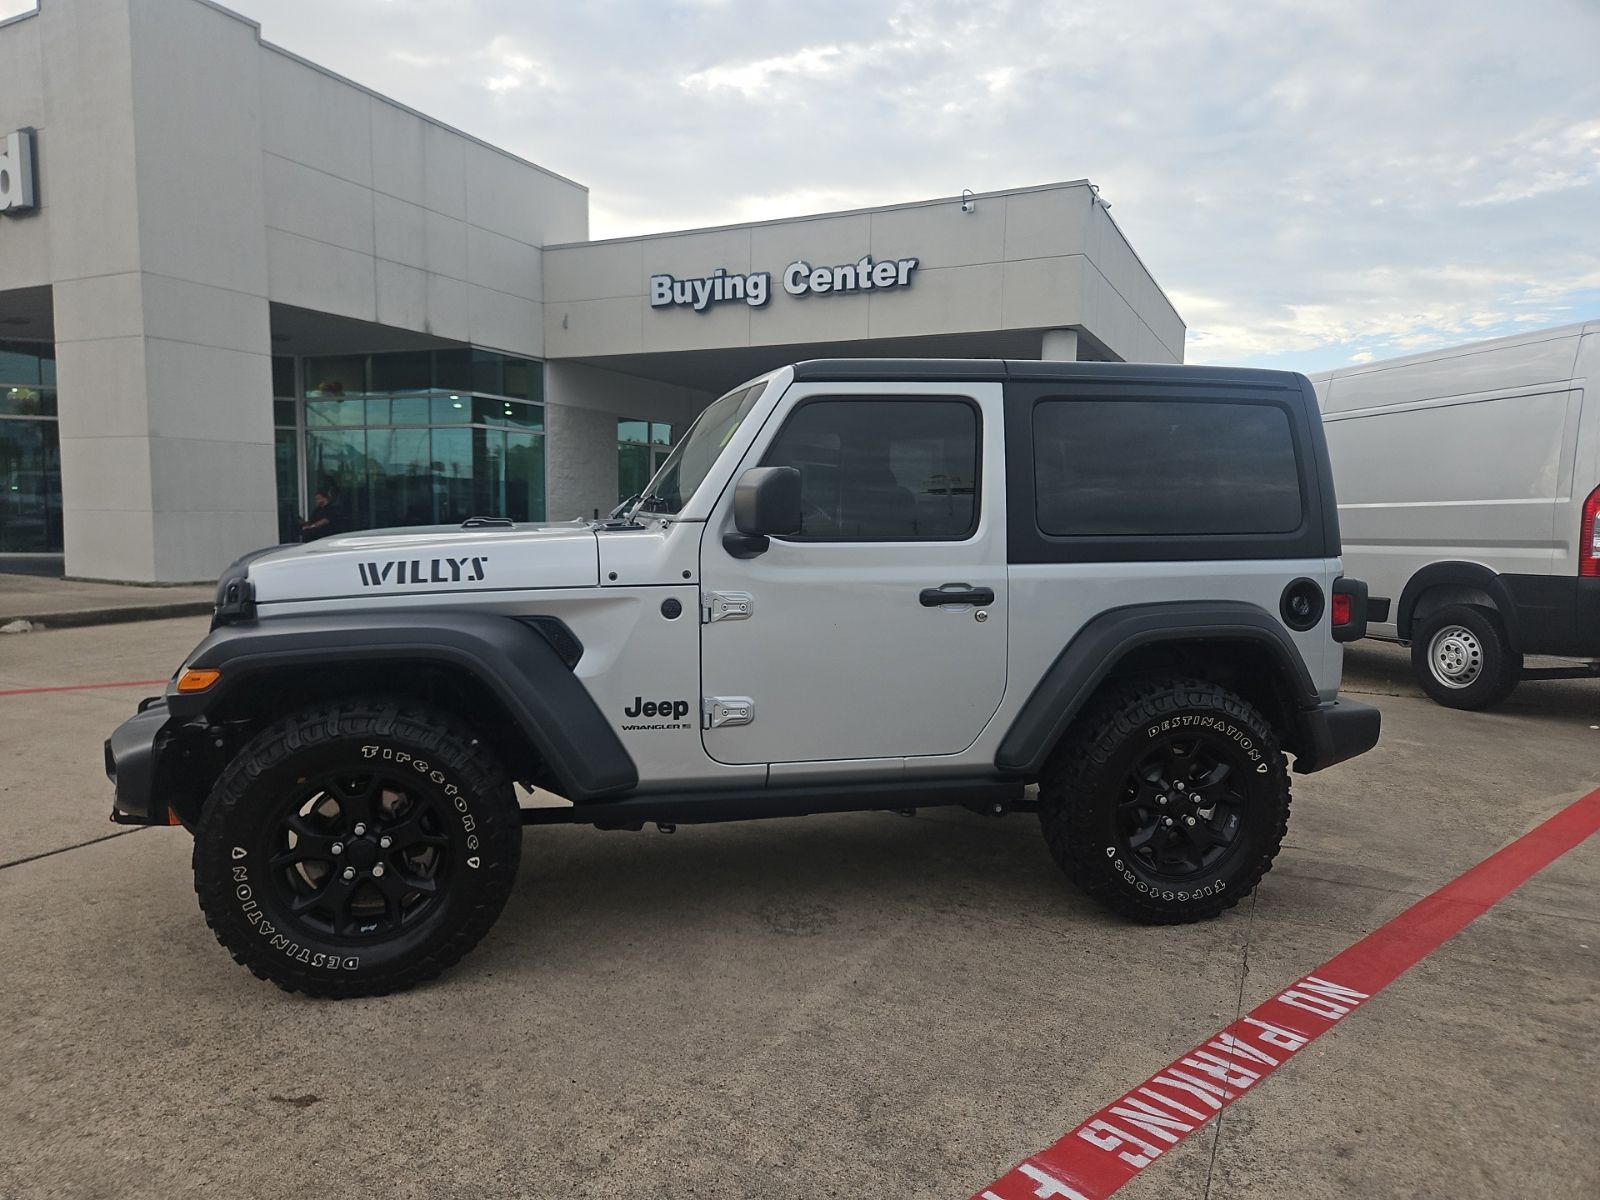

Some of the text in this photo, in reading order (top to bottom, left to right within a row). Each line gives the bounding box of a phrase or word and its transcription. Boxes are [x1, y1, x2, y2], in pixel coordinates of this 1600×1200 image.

[650, 255, 919, 313] Buying Center
[358, 557, 488, 586] WILLYS
[624, 696, 689, 720] Jeep
[1148, 715, 1262, 761] DESTINATION
[361, 745, 480, 850] Firestone
[1114, 859, 1226, 902] Firestone
[232, 866, 360, 970] DESTINATION
[1076, 976, 1370, 1168] NO PARKING
